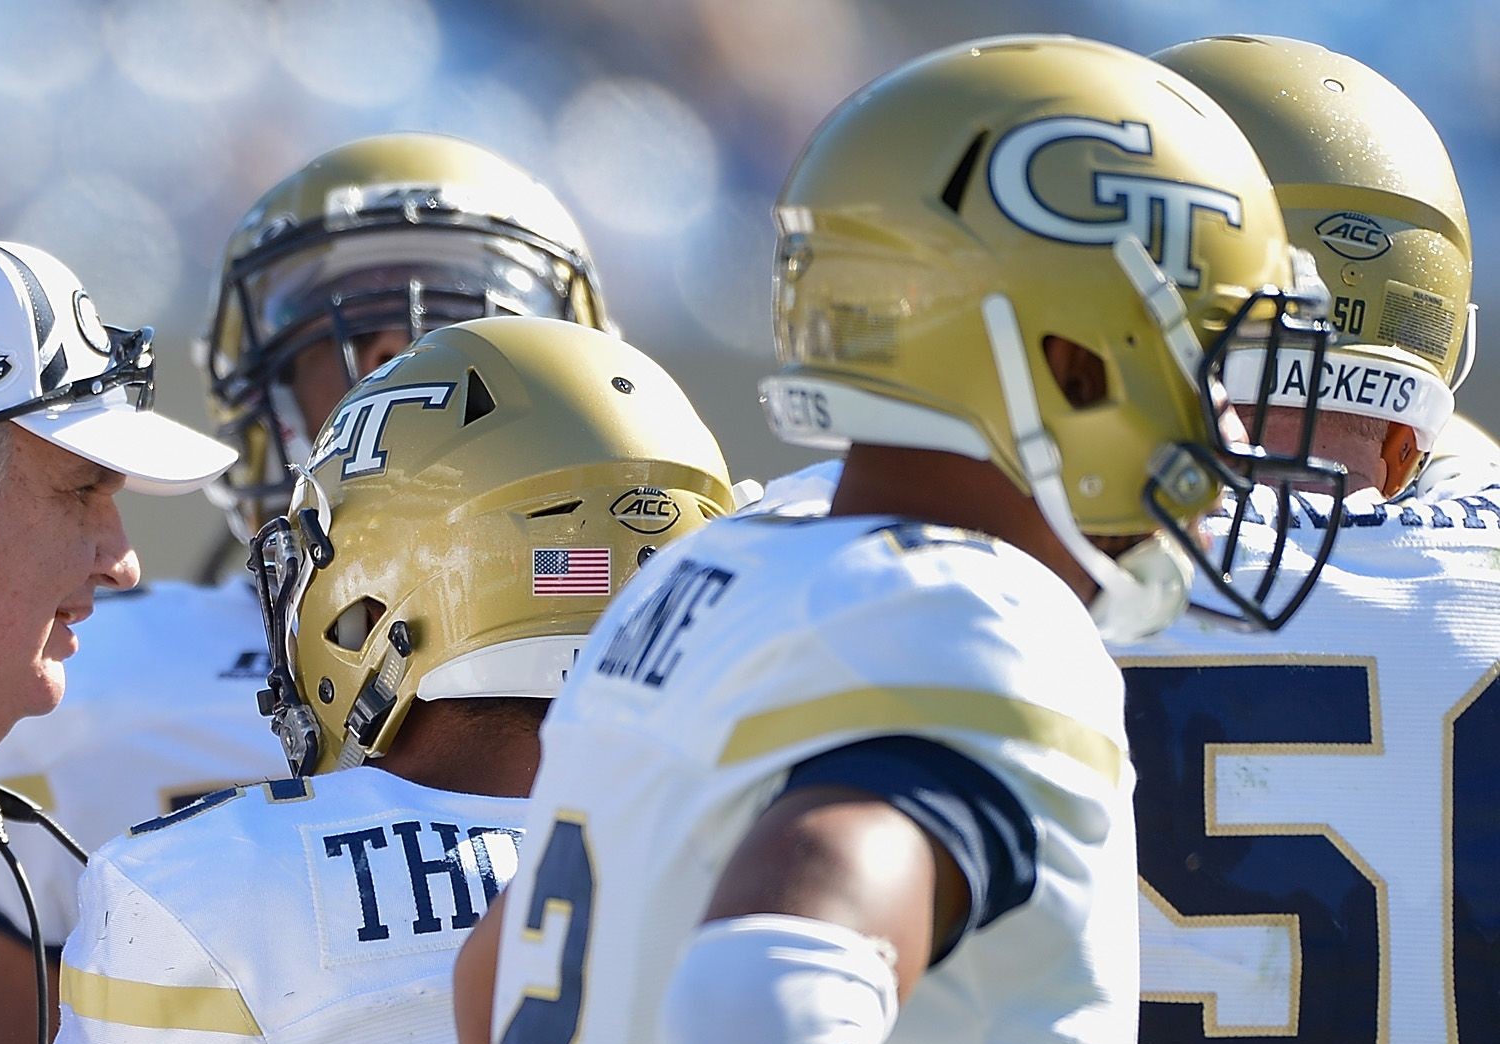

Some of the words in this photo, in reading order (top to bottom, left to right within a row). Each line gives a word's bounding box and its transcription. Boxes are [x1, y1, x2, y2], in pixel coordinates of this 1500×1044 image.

[987, 116, 1242, 288] GT
[1328, 223, 1384, 246] ACC
[1332, 296, 1366, 334] 50
[1268, 358, 1416, 415] JACKETS
[620, 499, 673, 517] ACC
